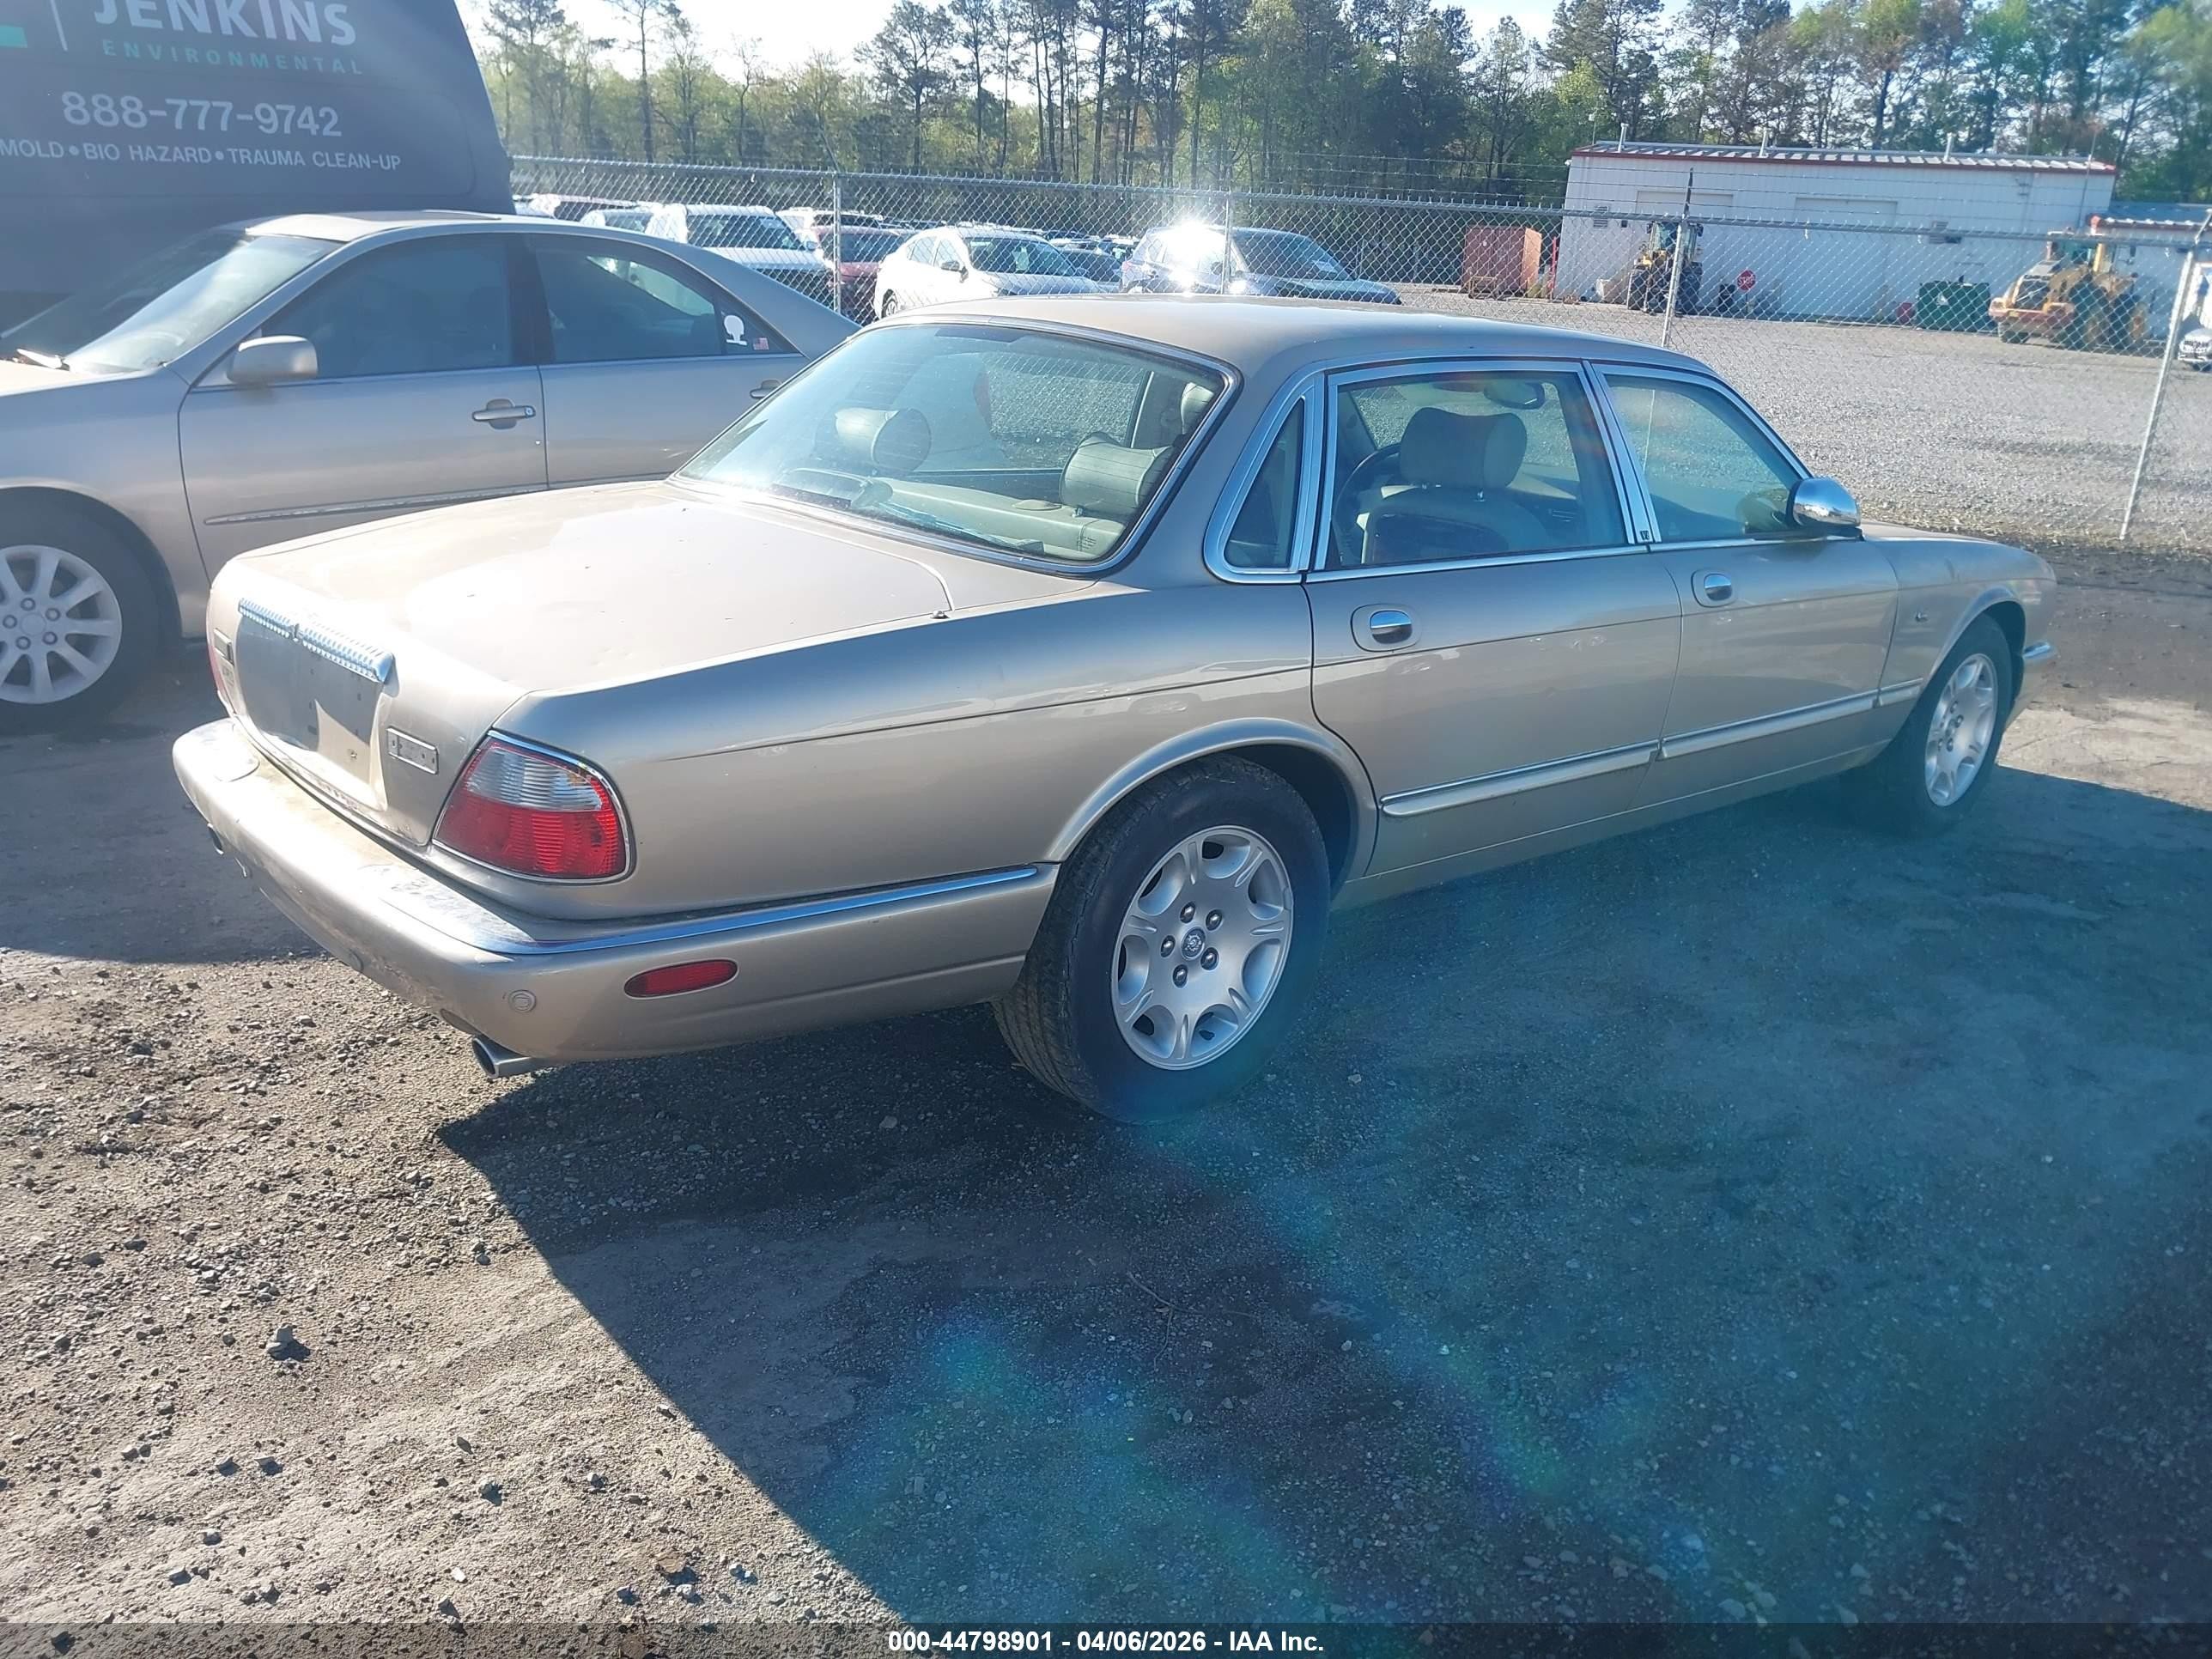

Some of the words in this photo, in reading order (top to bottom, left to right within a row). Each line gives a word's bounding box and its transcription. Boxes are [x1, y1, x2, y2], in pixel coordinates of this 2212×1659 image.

[94, 0, 356, 46] JENKINS
[102, 40, 362, 75] ENVIRONMENTAL
[62, 91, 342, 137] 888-777-9742
[0, 139, 64, 158] MOLD
[83, 143, 120, 161] BIO
[129, 145, 212, 164] HAZARD
[227, 148, 306, 166] TRAUMA
[313, 151, 401, 171] CLEAN-UP
